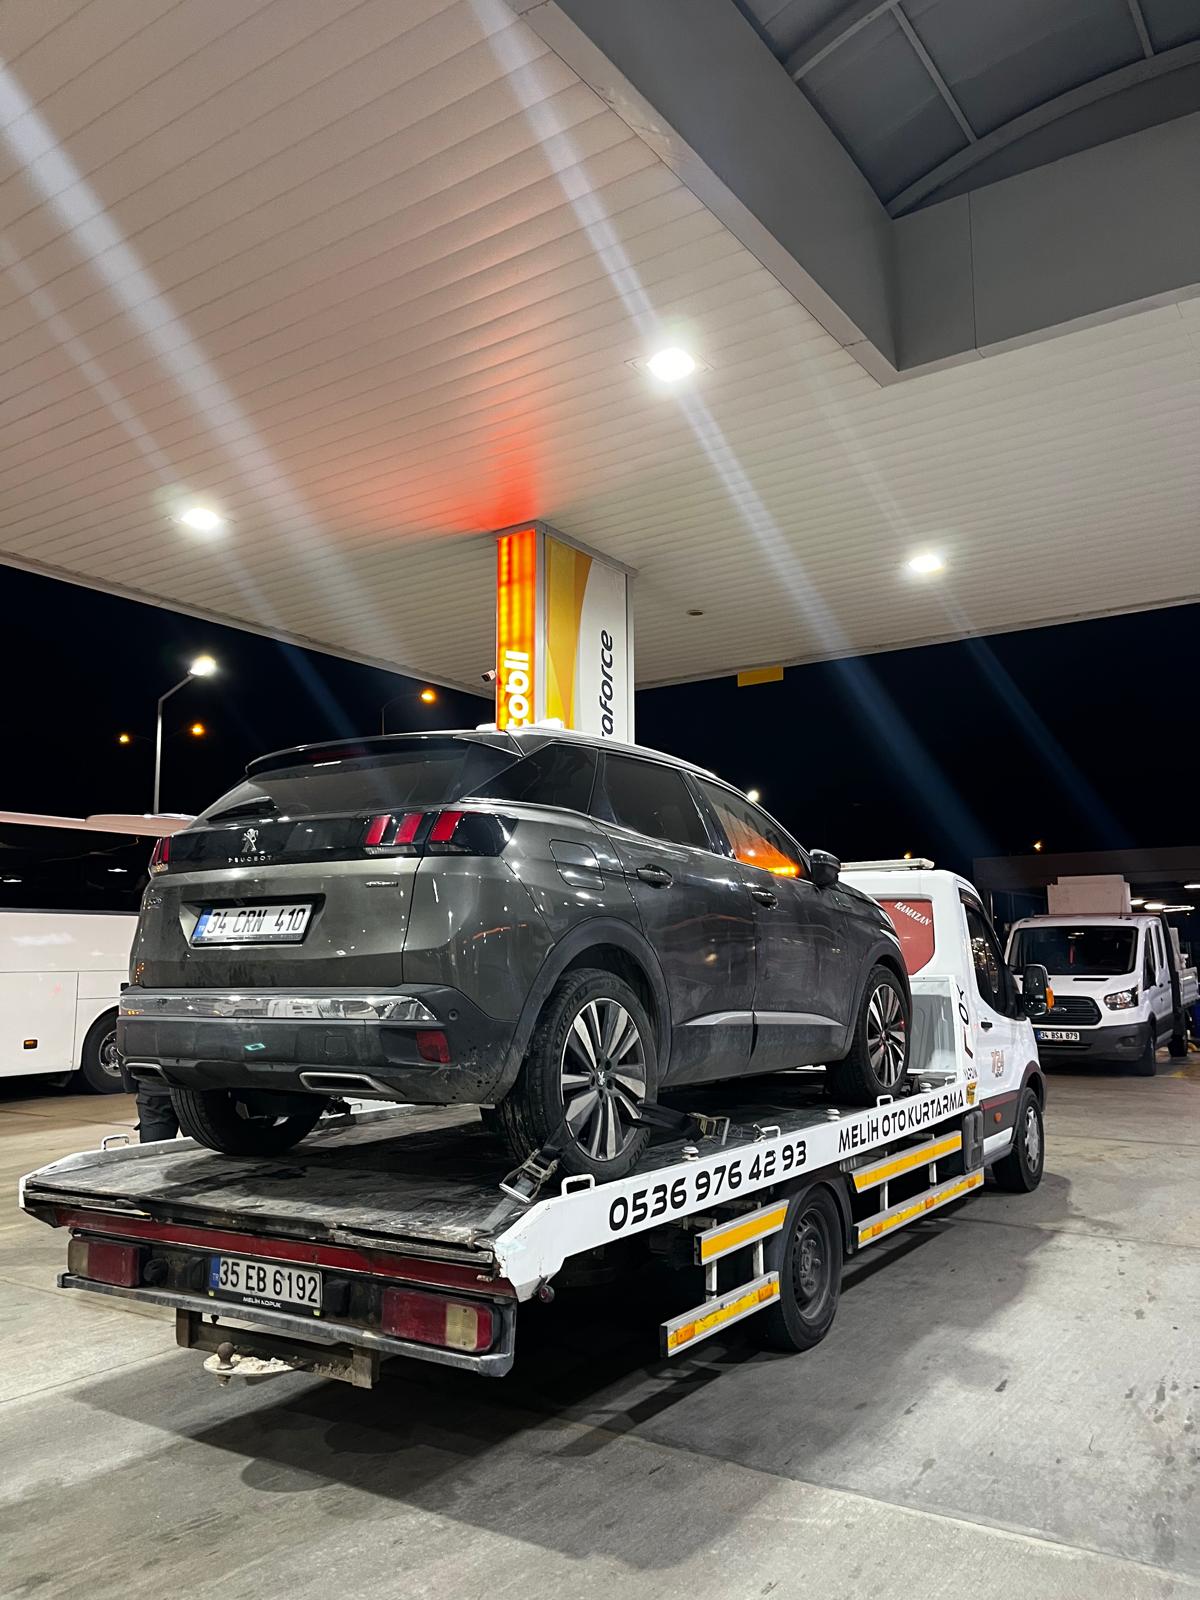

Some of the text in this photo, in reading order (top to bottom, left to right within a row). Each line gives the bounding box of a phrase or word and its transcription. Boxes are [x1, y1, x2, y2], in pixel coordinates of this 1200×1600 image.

[599, 630, 613, 737] aforce
[206, 907, 306, 934] 34 CRN 410
[894, 901, 932, 926] RAMAZAN
[1040, 1031, 1078, 1040] 34 BSA 879
[838, 1089, 964, 1153] MELİH OTO KURTARMA
[608, 1139, 807, 1232] 0536 976 42 93
[220, 1260, 318, 1304] 35 EB 6192
